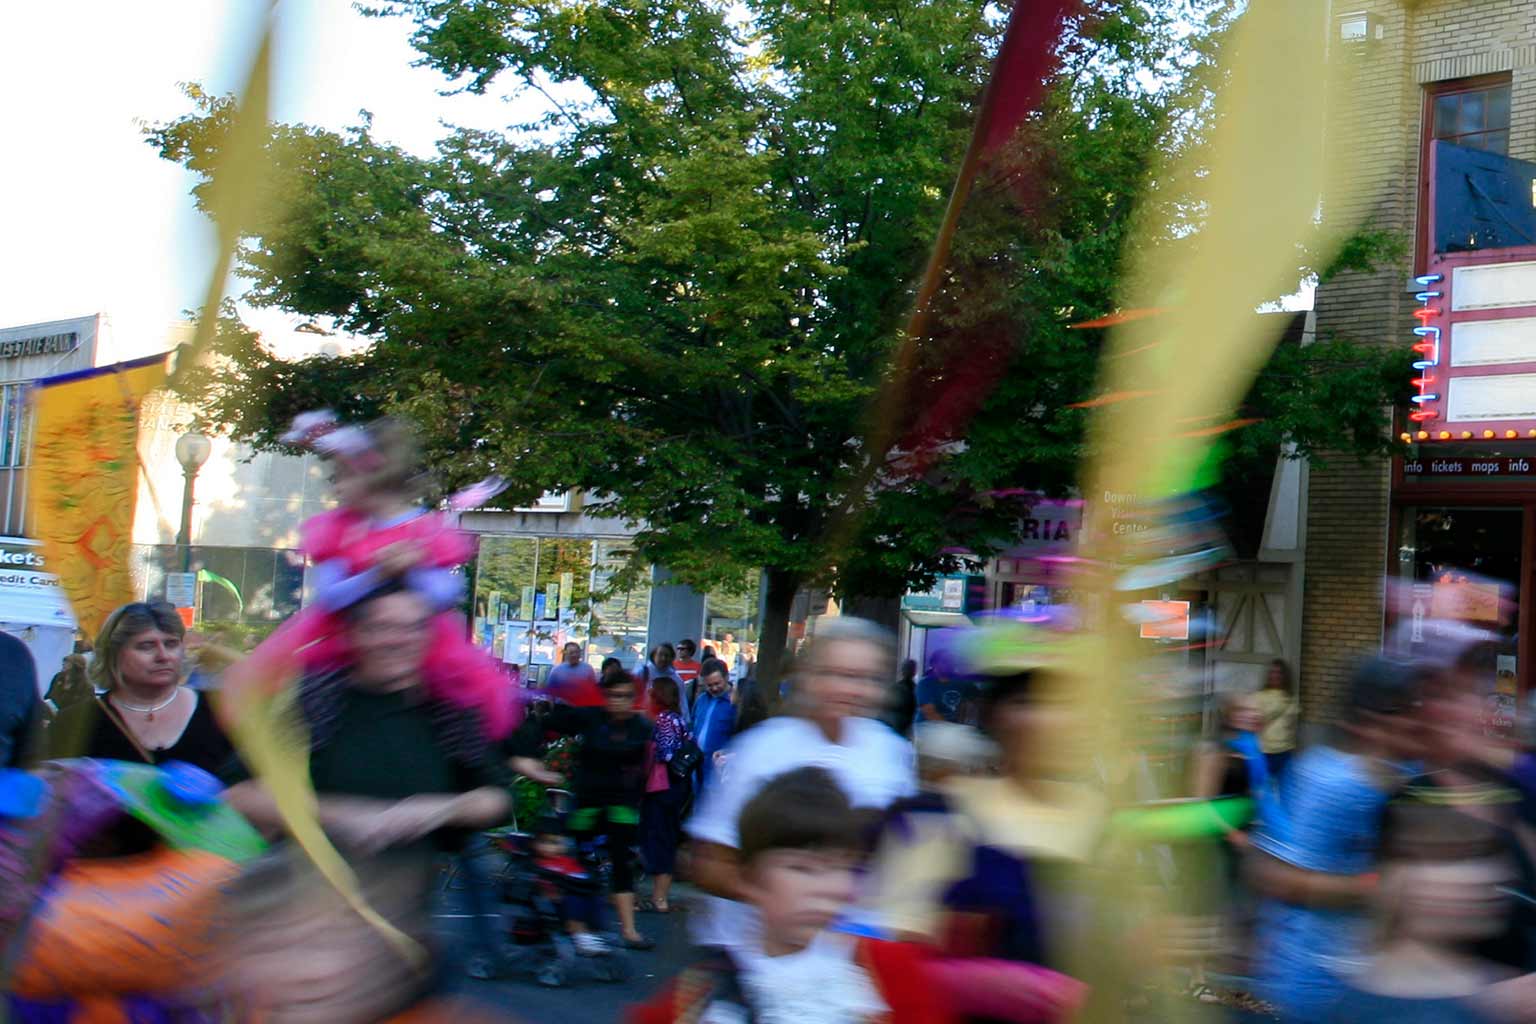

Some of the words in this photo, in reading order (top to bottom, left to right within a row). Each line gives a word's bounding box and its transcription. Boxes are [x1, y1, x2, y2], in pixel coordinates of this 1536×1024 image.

[1404, 460, 1423, 473] info
[1431, 459, 1462, 472] tickets
[1471, 460, 1499, 474] maps
[1508, 458, 1529, 471] info
